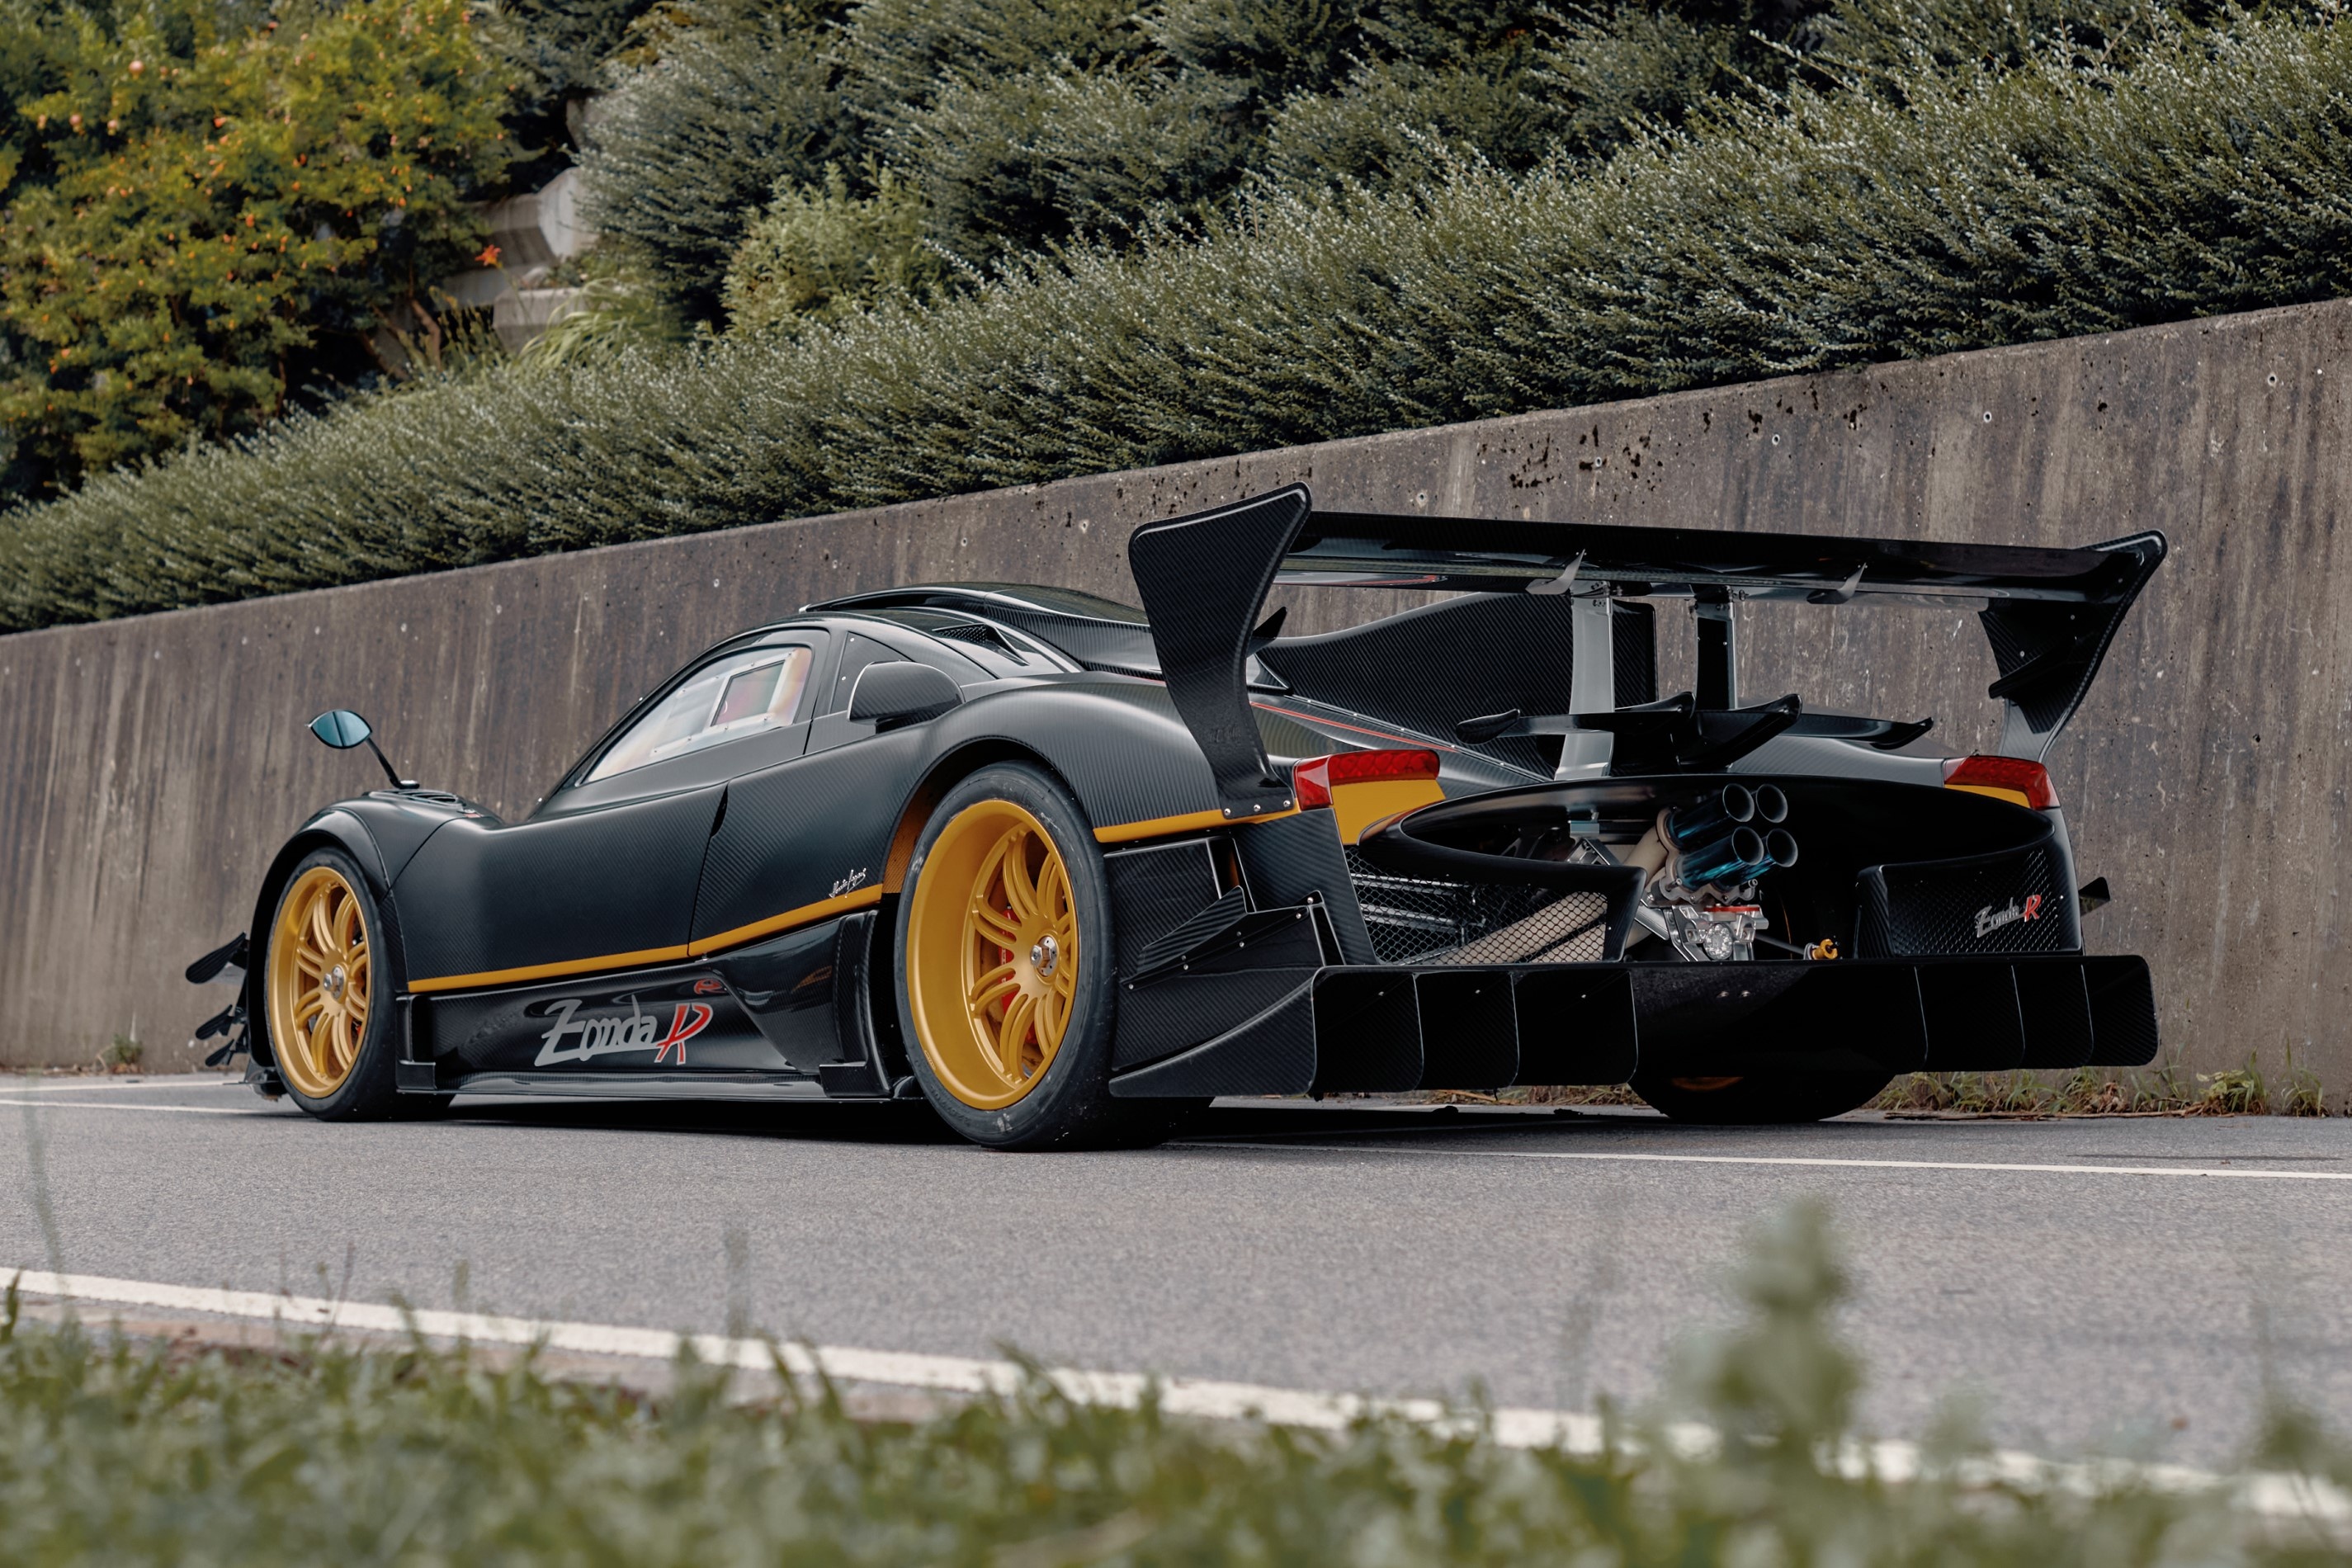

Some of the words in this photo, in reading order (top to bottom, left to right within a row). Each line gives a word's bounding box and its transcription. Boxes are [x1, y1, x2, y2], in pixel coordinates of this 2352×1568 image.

[1975, 897, 2024, 937] Zonda
[2024, 895, 2041, 922] R
[534, 994, 658, 1066] Zonda
[654, 1003, 713, 1065] R
